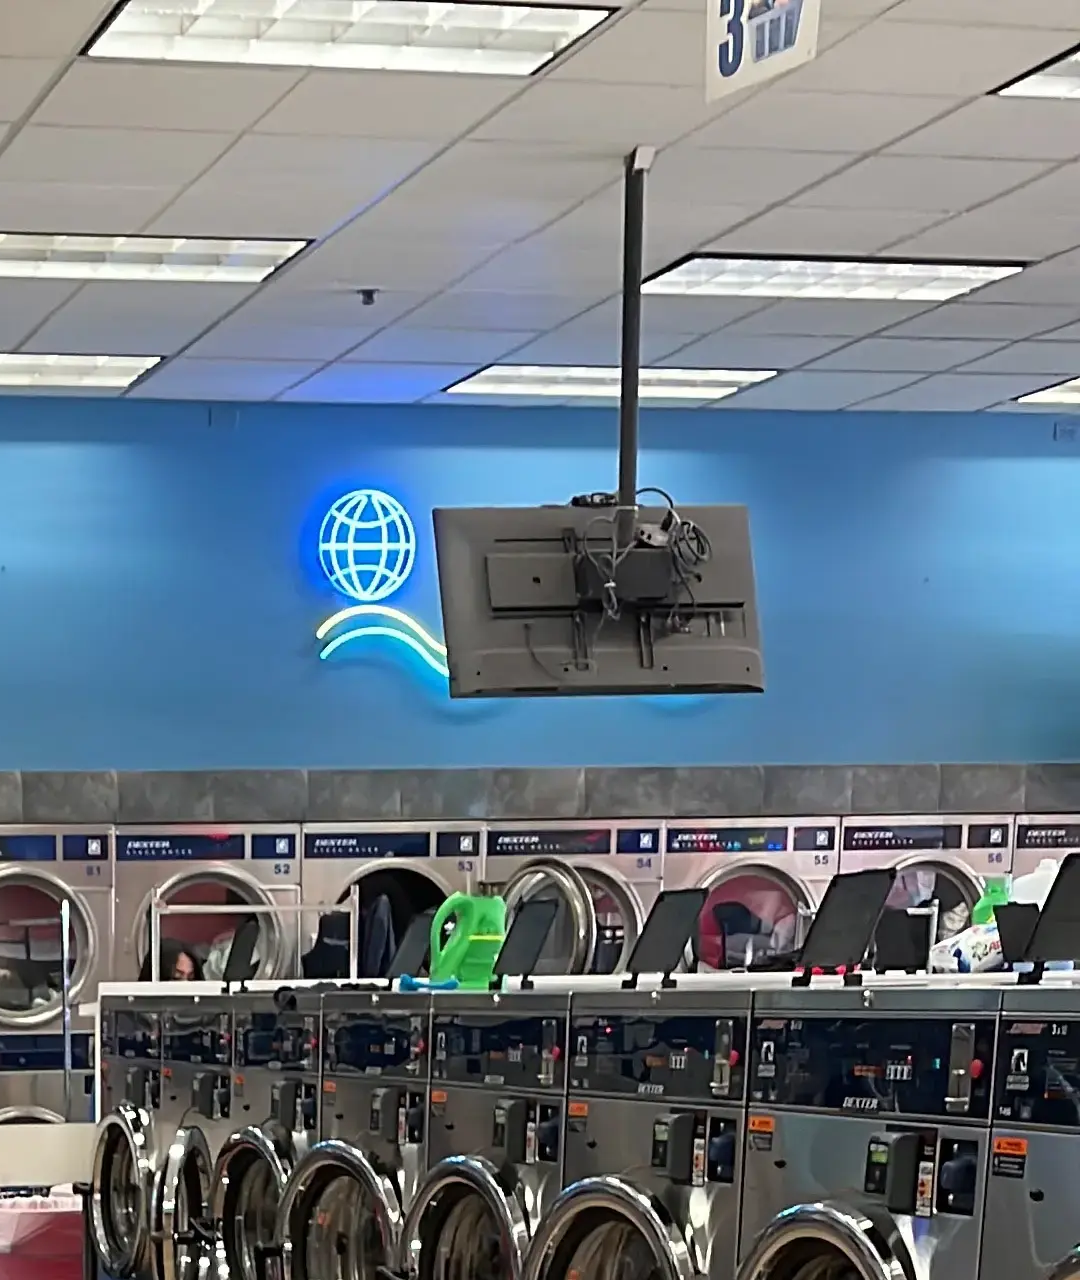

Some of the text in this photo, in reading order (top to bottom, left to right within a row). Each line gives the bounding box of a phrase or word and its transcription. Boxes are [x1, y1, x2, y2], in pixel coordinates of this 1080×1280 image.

[718, 0, 744, 77] 3
[814, 854, 829, 866] 55
[273, 863, 291, 875] 52
[842, 1095, 879, 1110] DEXTER
